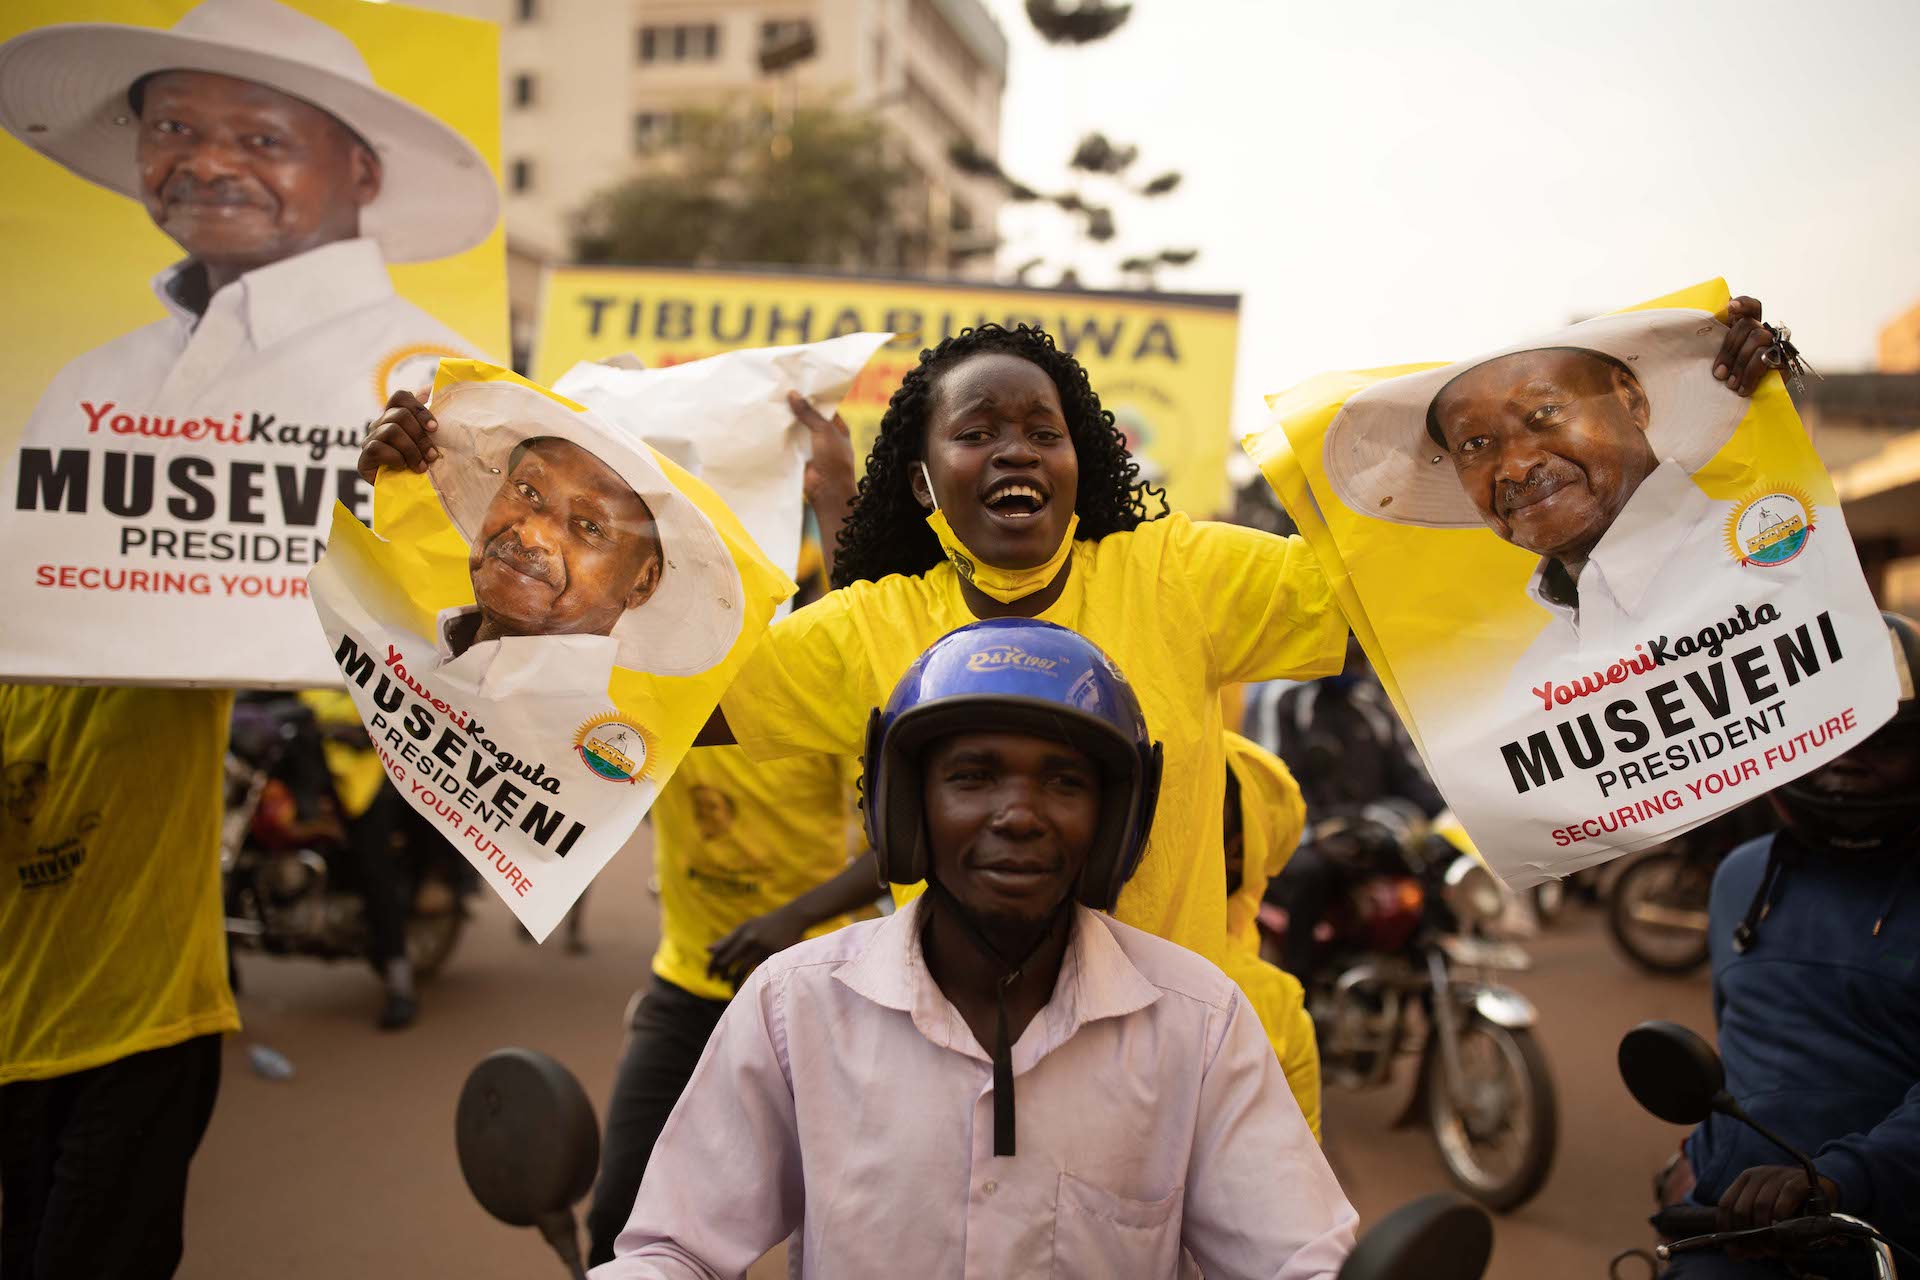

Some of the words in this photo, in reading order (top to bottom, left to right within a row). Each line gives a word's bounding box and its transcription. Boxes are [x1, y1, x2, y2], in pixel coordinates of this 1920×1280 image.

[16, 447, 373, 529] MUSEVE
[120, 526, 328, 565] PRESIDE
[36, 564, 212, 595] SECURING
[221, 573, 309, 599] YOUR
[335, 634, 586, 858] MUSEVENI
[1500, 610, 1844, 794] MUSEVENI
[1596, 700, 1787, 798] PRESIDENT
[370, 712, 510, 833] PRESIDENT
[1551, 789, 1684, 847] SECURING
[1684, 758, 1761, 801] YOUR
[1763, 707, 1858, 771] FUTURE
[411, 778, 464, 829] YOUR
[464, 825, 533, 898] FUTURE
